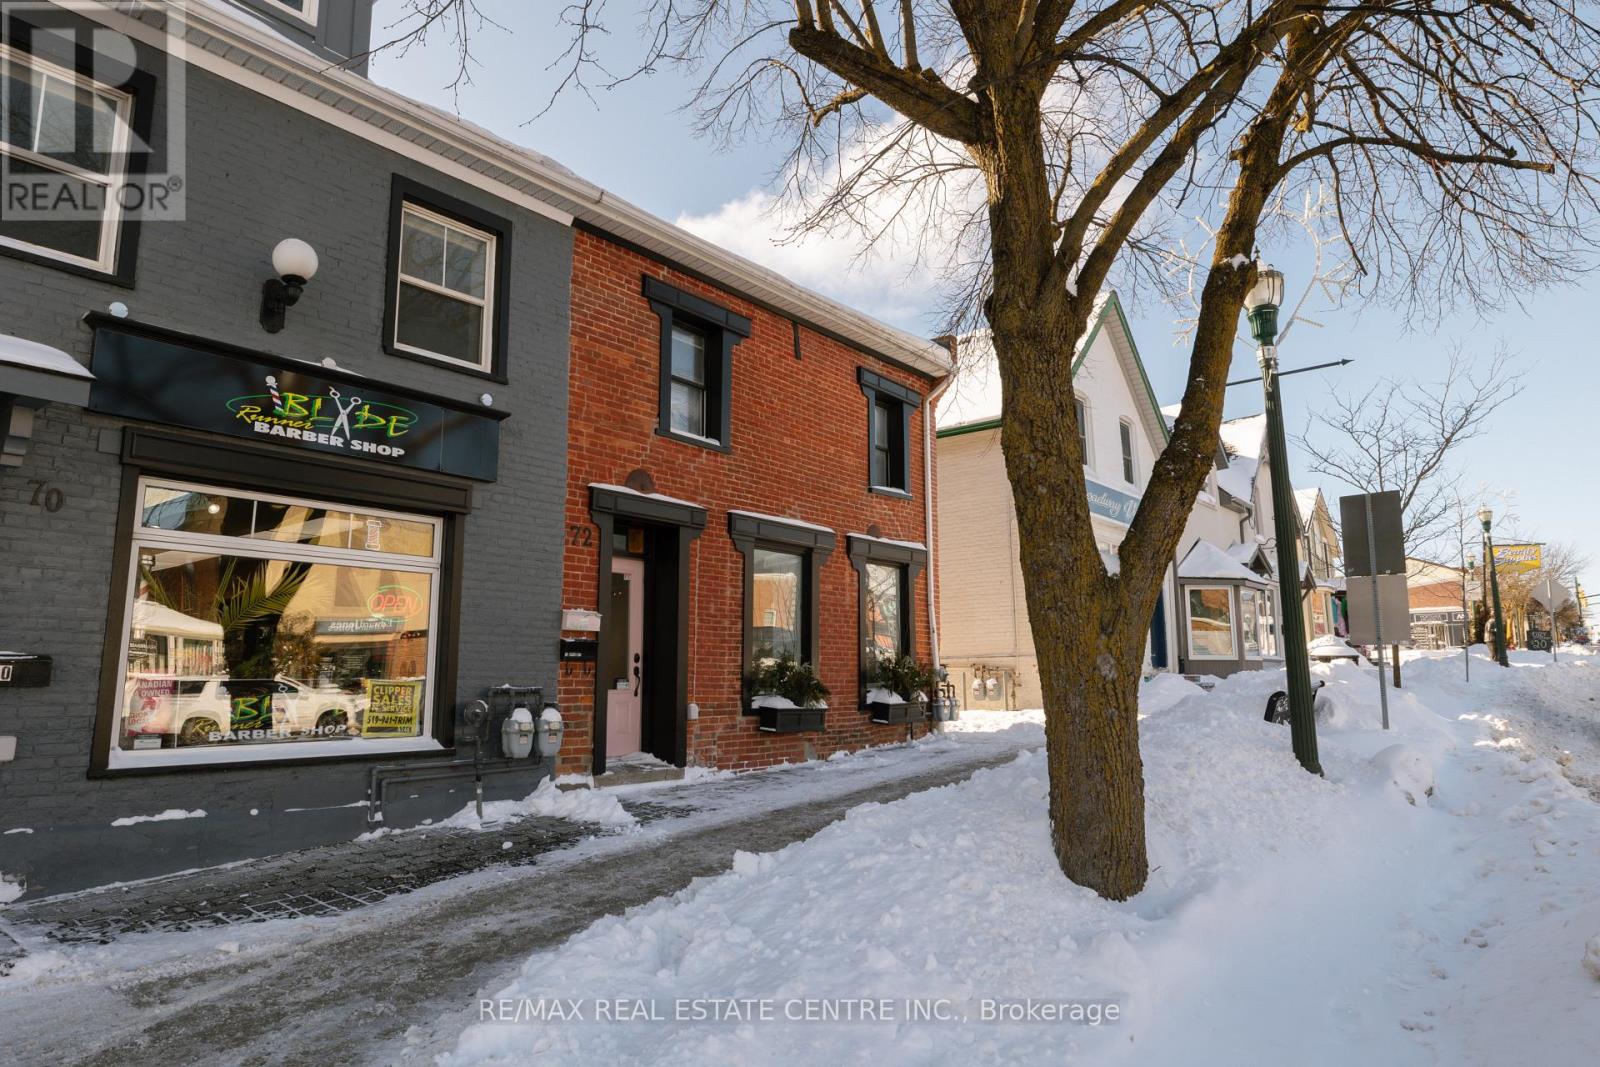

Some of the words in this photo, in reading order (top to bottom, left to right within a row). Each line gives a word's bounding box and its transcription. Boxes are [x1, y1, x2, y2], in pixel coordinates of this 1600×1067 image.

[235, 404, 315, 431] Runner
[253, 421, 345, 448] BARBER
[350, 439, 406, 458] SHOP
[26, 479, 64, 513] 70
[569, 525, 593, 547] 72
[370, 594, 417, 612] OPEN
[136, 680, 173, 689] ANADIAN
[373, 686, 413, 696] CLIPPER
[373, 695, 412, 705] SALES
[208, 728, 293, 741] BARBER
[300, 724, 348, 736] SHOP
